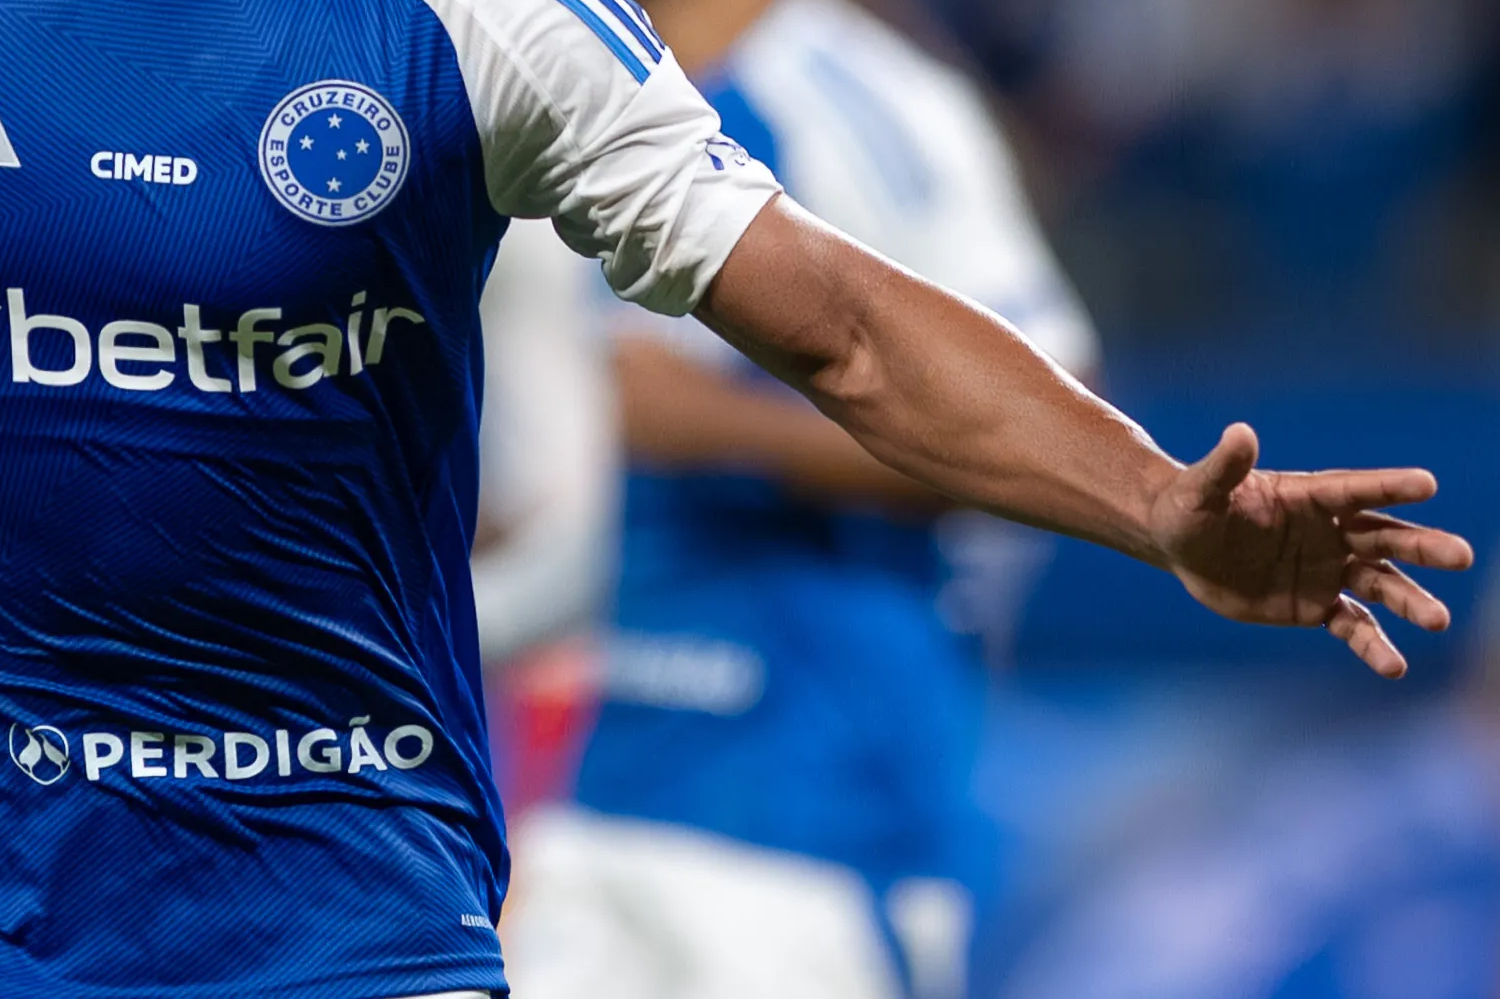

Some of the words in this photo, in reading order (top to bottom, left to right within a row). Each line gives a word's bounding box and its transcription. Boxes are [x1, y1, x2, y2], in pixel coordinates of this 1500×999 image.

[280, 91, 391, 131] CRUZEIRO
[91, 151, 198, 185] CIMED
[270, 139, 342, 216] ESPORTE
[354, 145, 400, 211] CLUBE
[6, 287, 425, 393] betfair
[82, 714, 434, 782] PERDIGÃO
